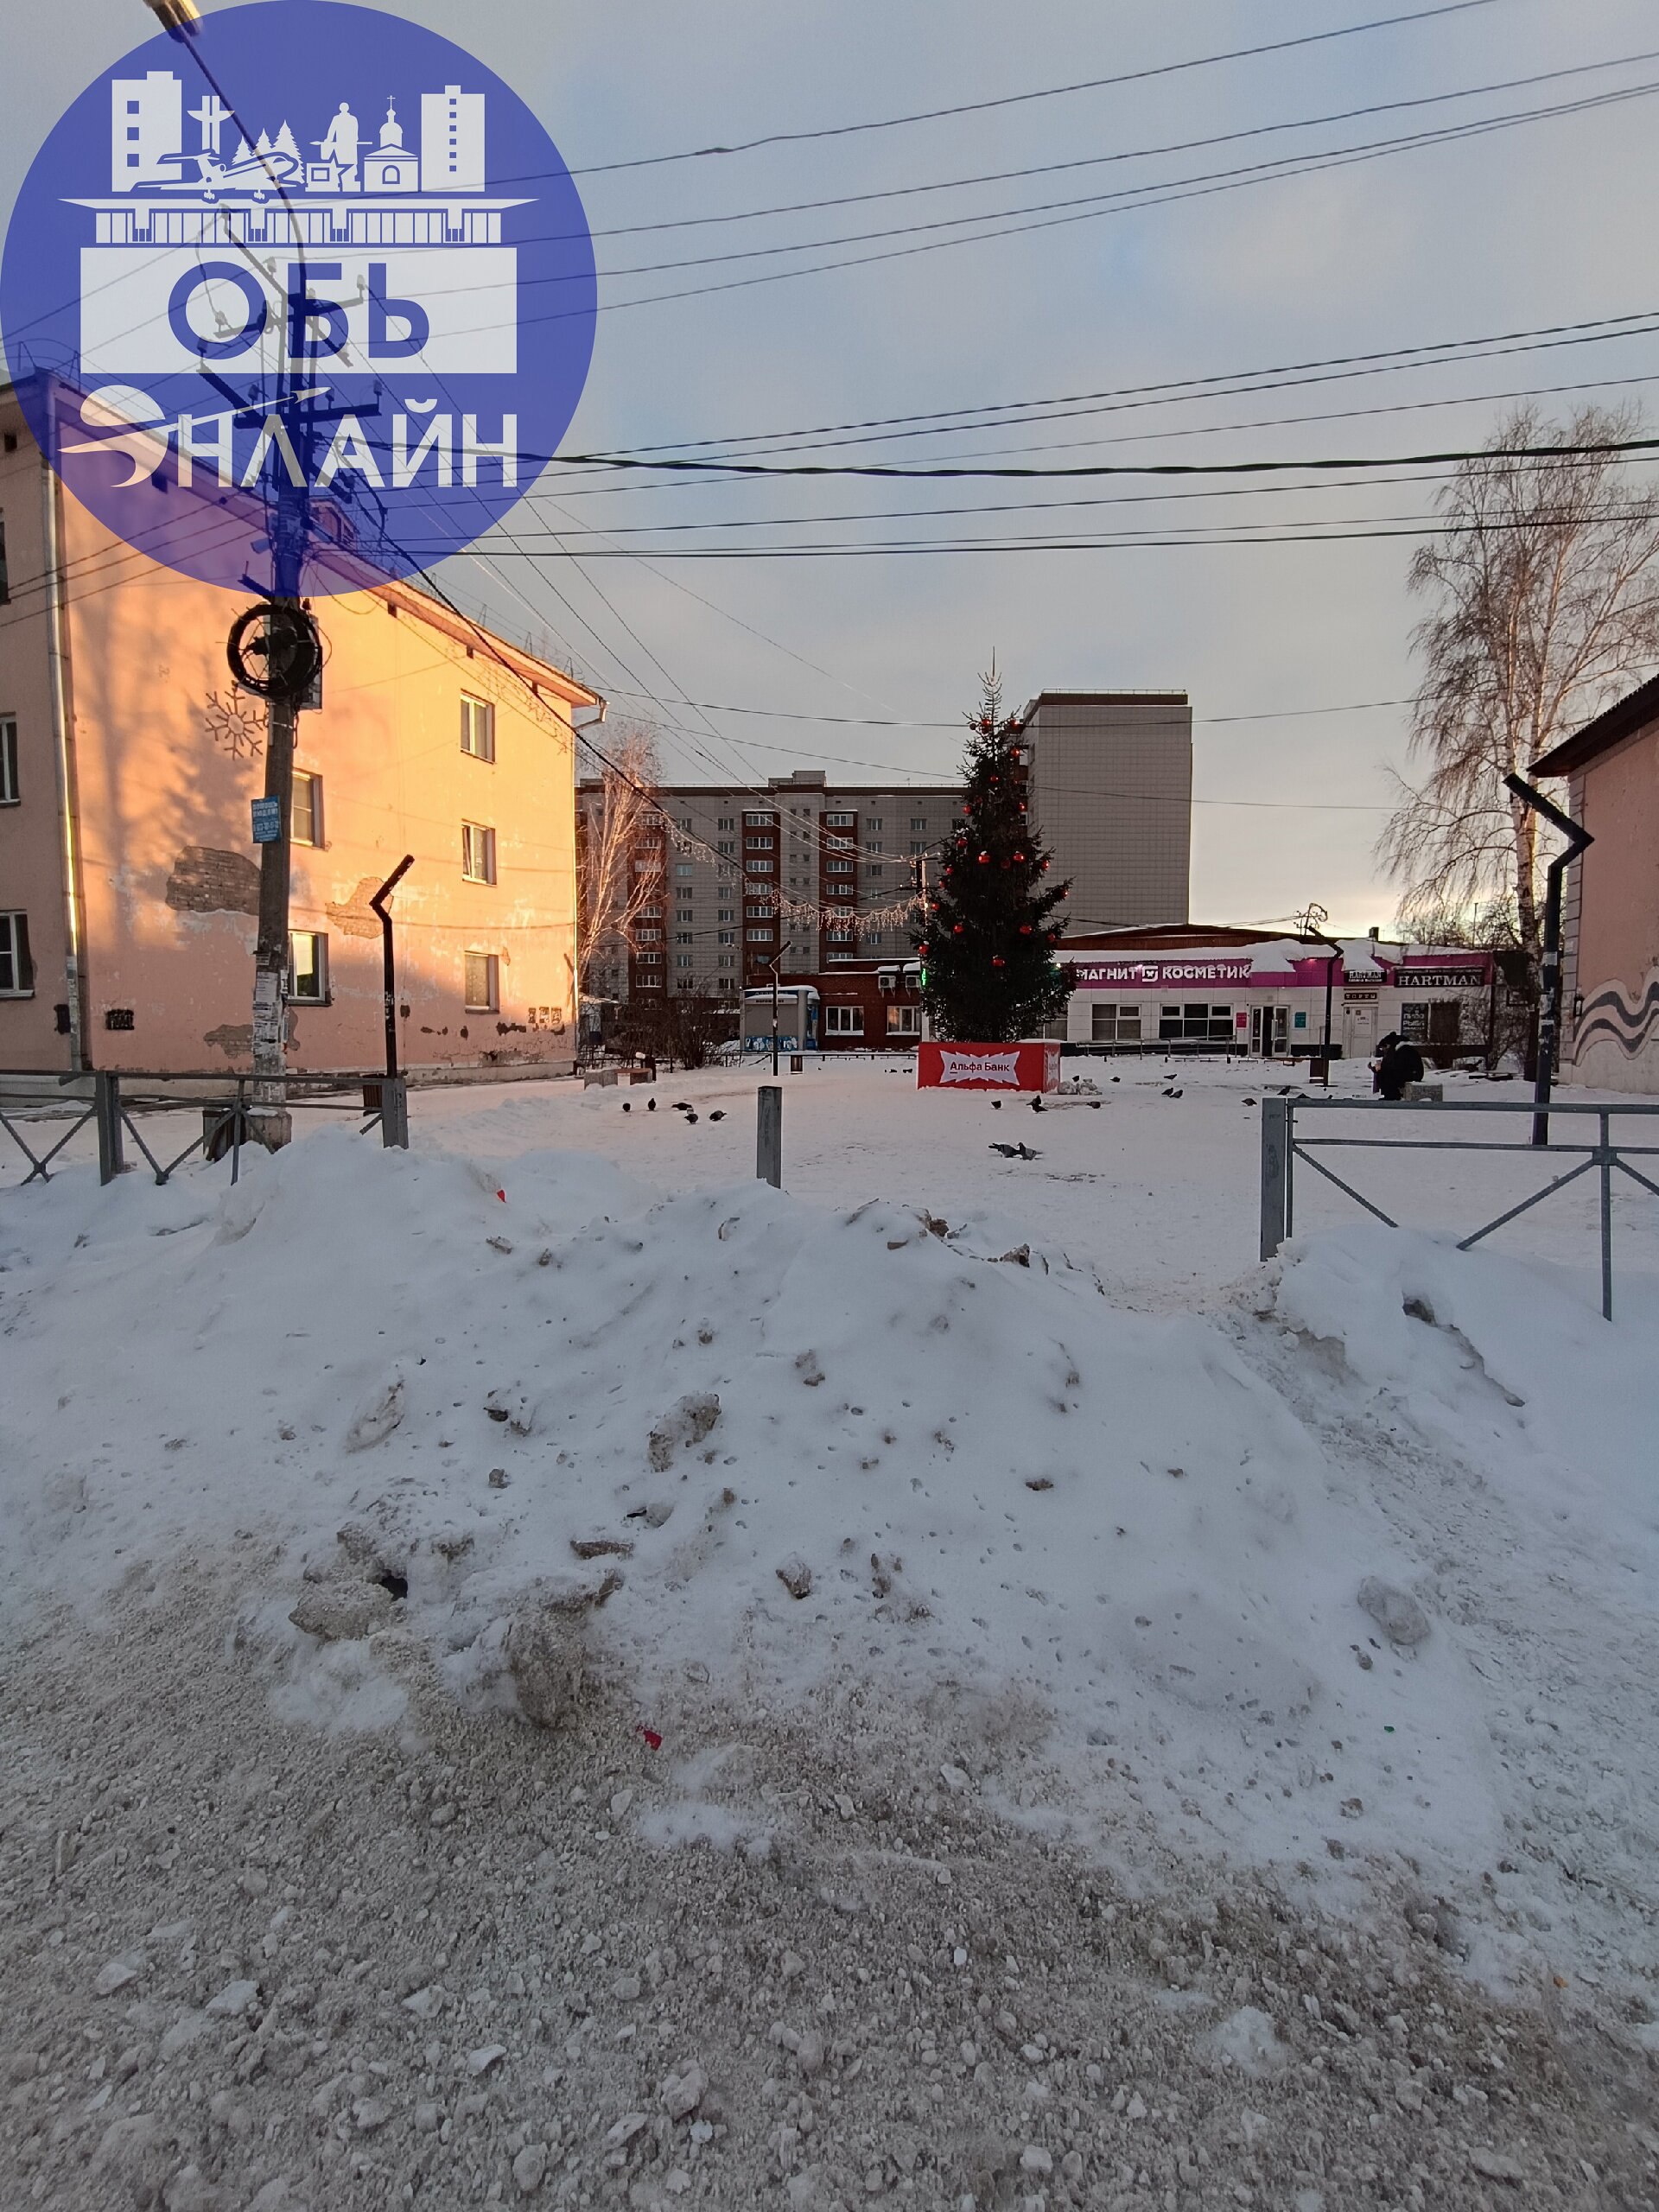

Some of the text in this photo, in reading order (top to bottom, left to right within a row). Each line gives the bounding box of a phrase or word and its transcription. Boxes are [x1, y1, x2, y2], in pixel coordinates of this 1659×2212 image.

[1076, 964, 1252, 981] МАГНИТ КОСМЕТИК
[1398, 975, 1482, 986] HARTMAN
[950, 1061, 1010, 1074] Альфа Банк
